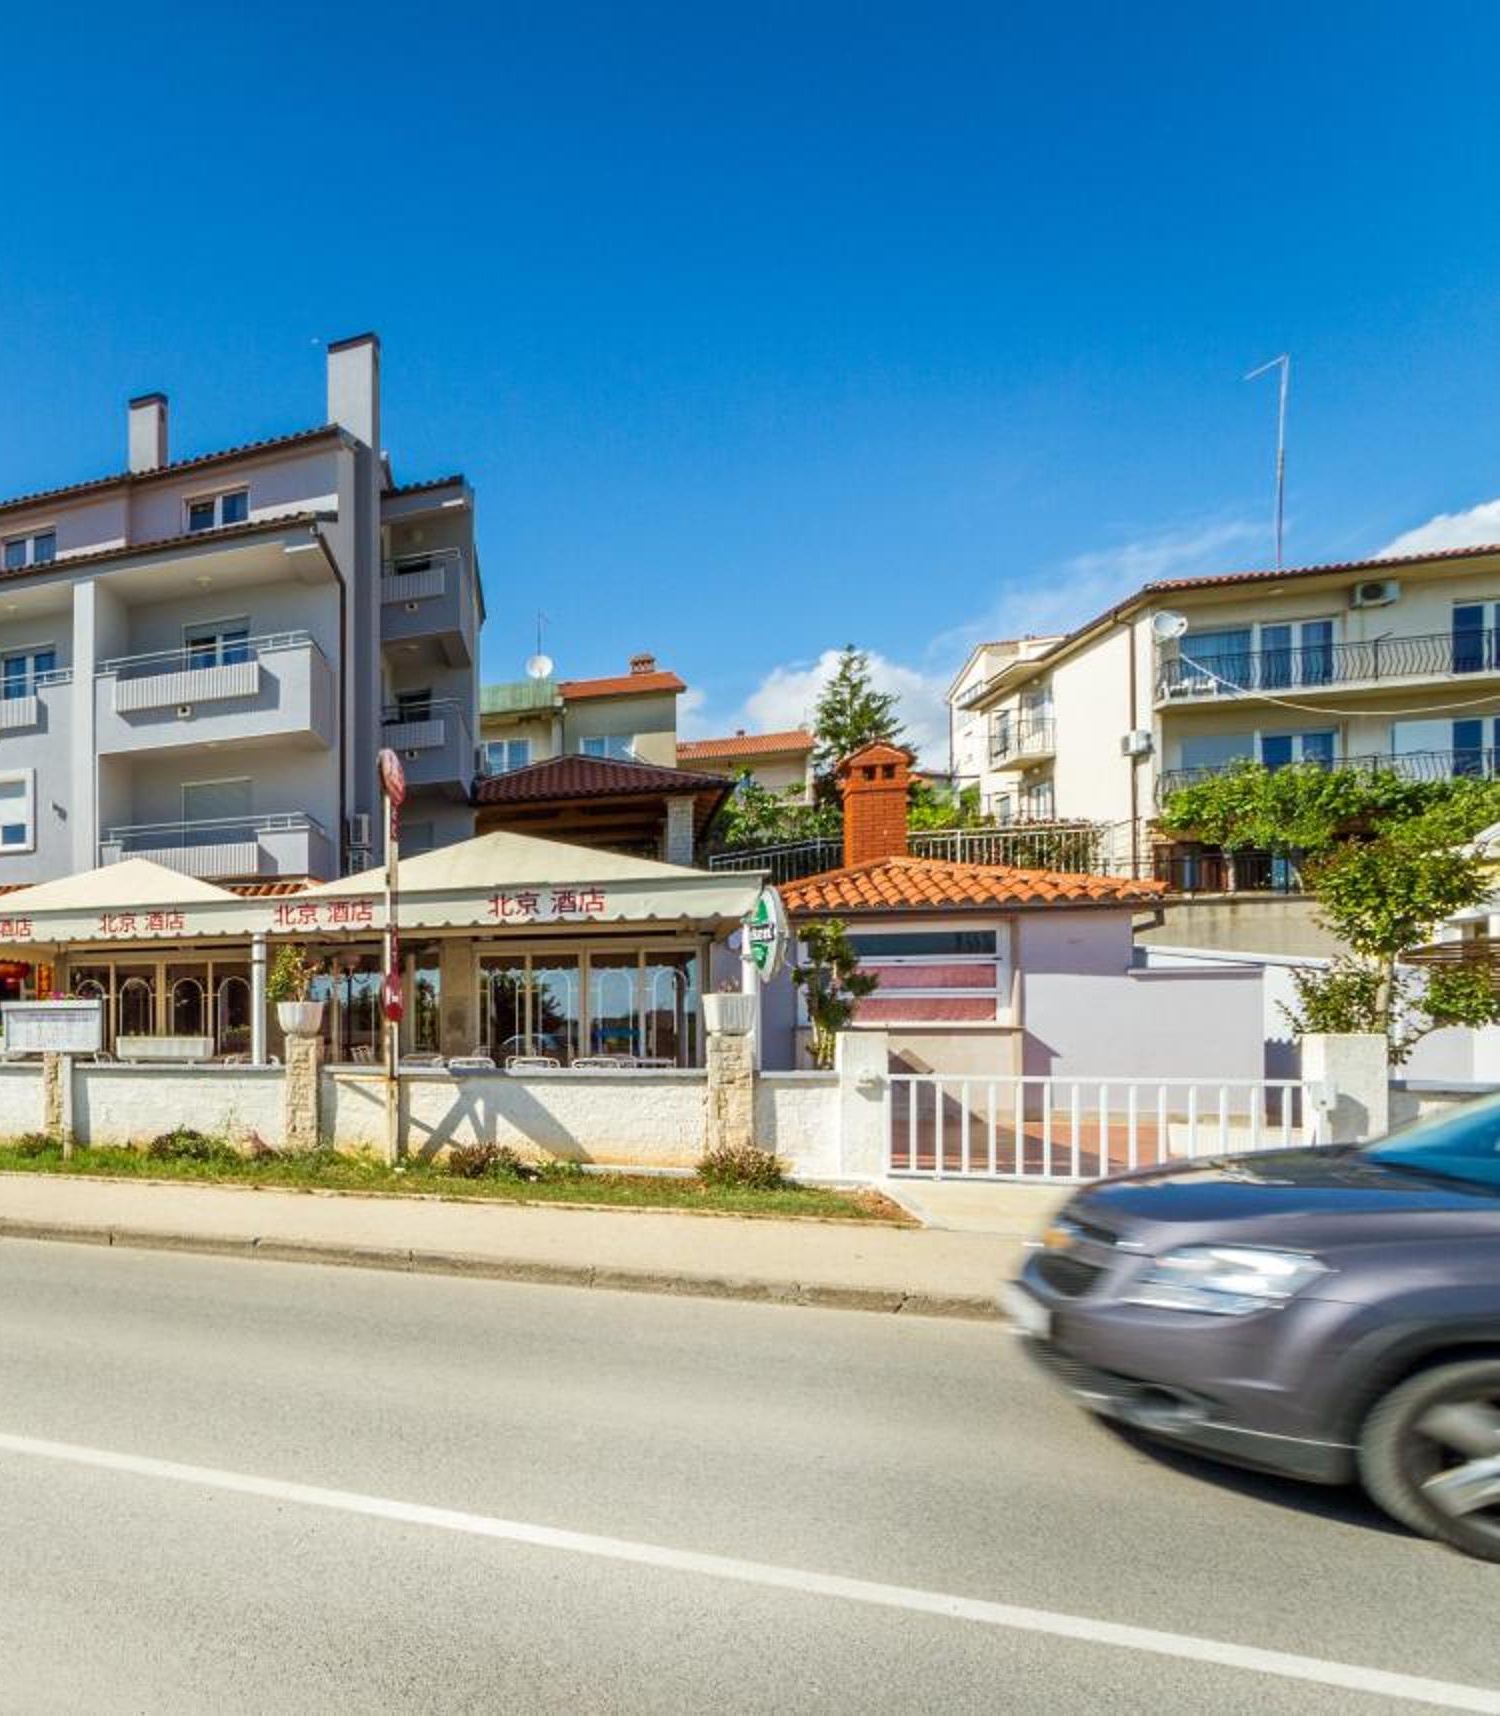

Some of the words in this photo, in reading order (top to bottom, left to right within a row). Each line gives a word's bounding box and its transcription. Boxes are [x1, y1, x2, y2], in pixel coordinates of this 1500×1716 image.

[274, 902, 318, 926] 北京
[326, 900, 373, 923] 酒店
[488, 891, 541, 917] 北京
[551, 888, 606, 913] 酒店
[98, 912, 137, 934] 北京
[144, 908, 185, 931] 酒店
